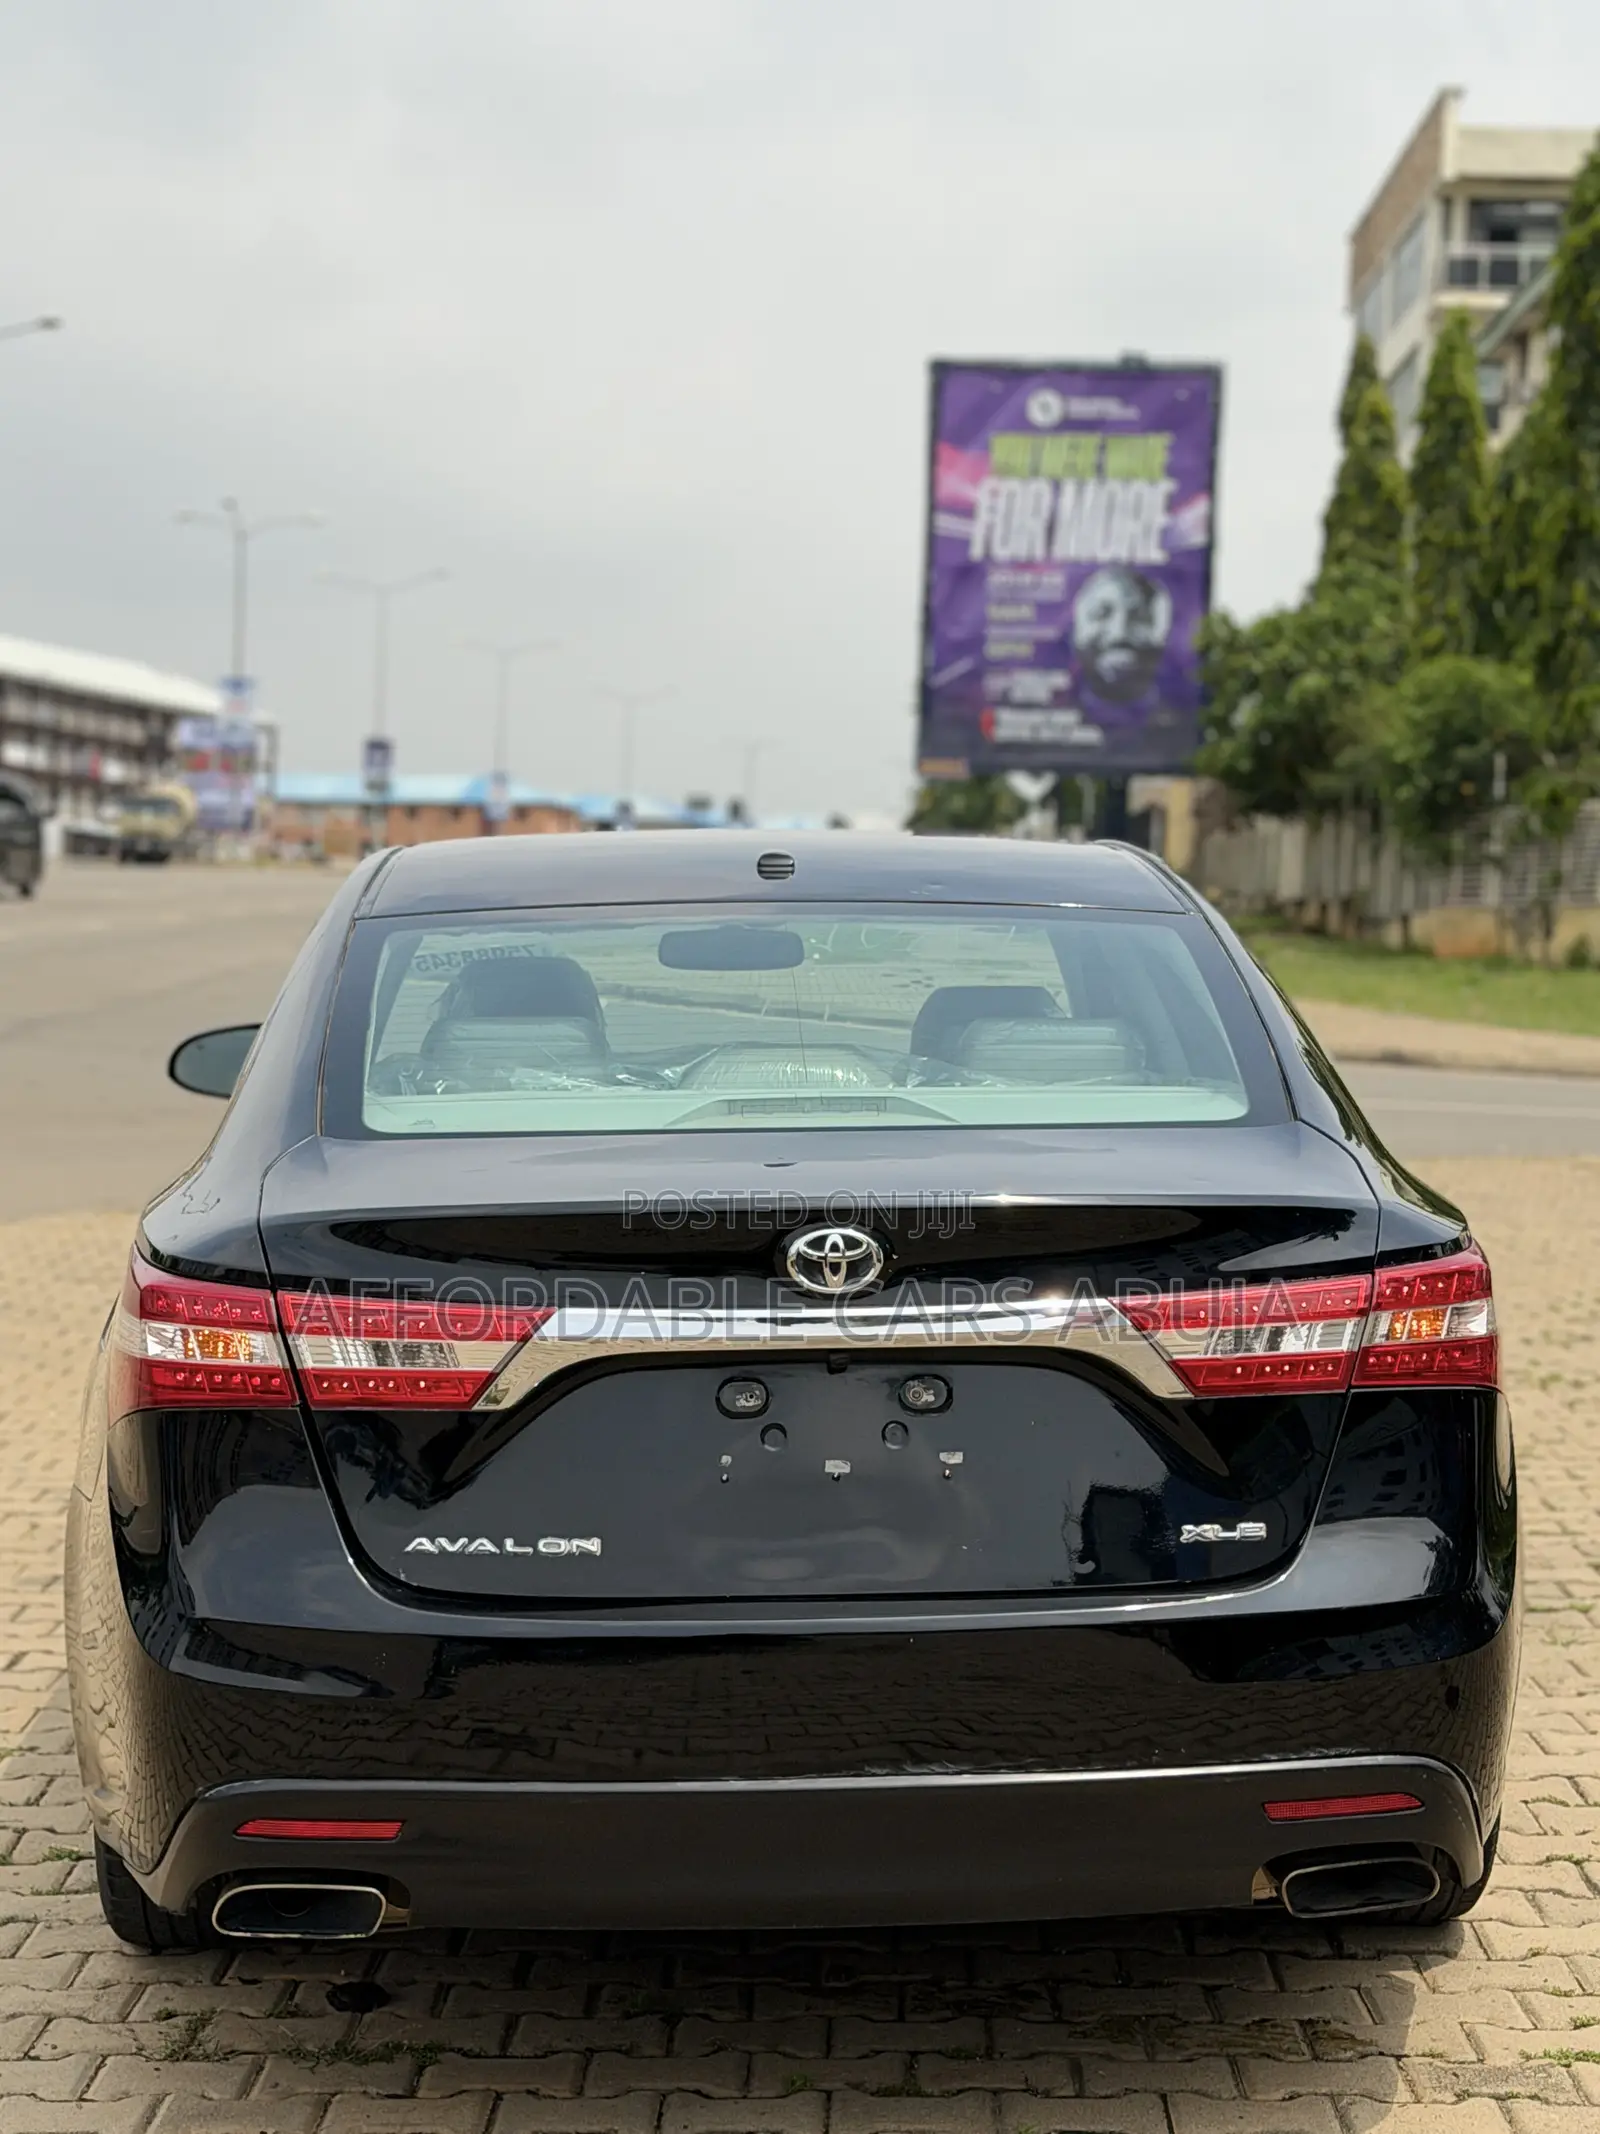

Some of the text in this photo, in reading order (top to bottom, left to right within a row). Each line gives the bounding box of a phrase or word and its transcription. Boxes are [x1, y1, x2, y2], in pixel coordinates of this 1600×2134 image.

[968, 477, 1177, 562] FOR MORE
[1180, 1522, 1267, 1543] XLE
[404, 1536, 602, 1556] AVALON
